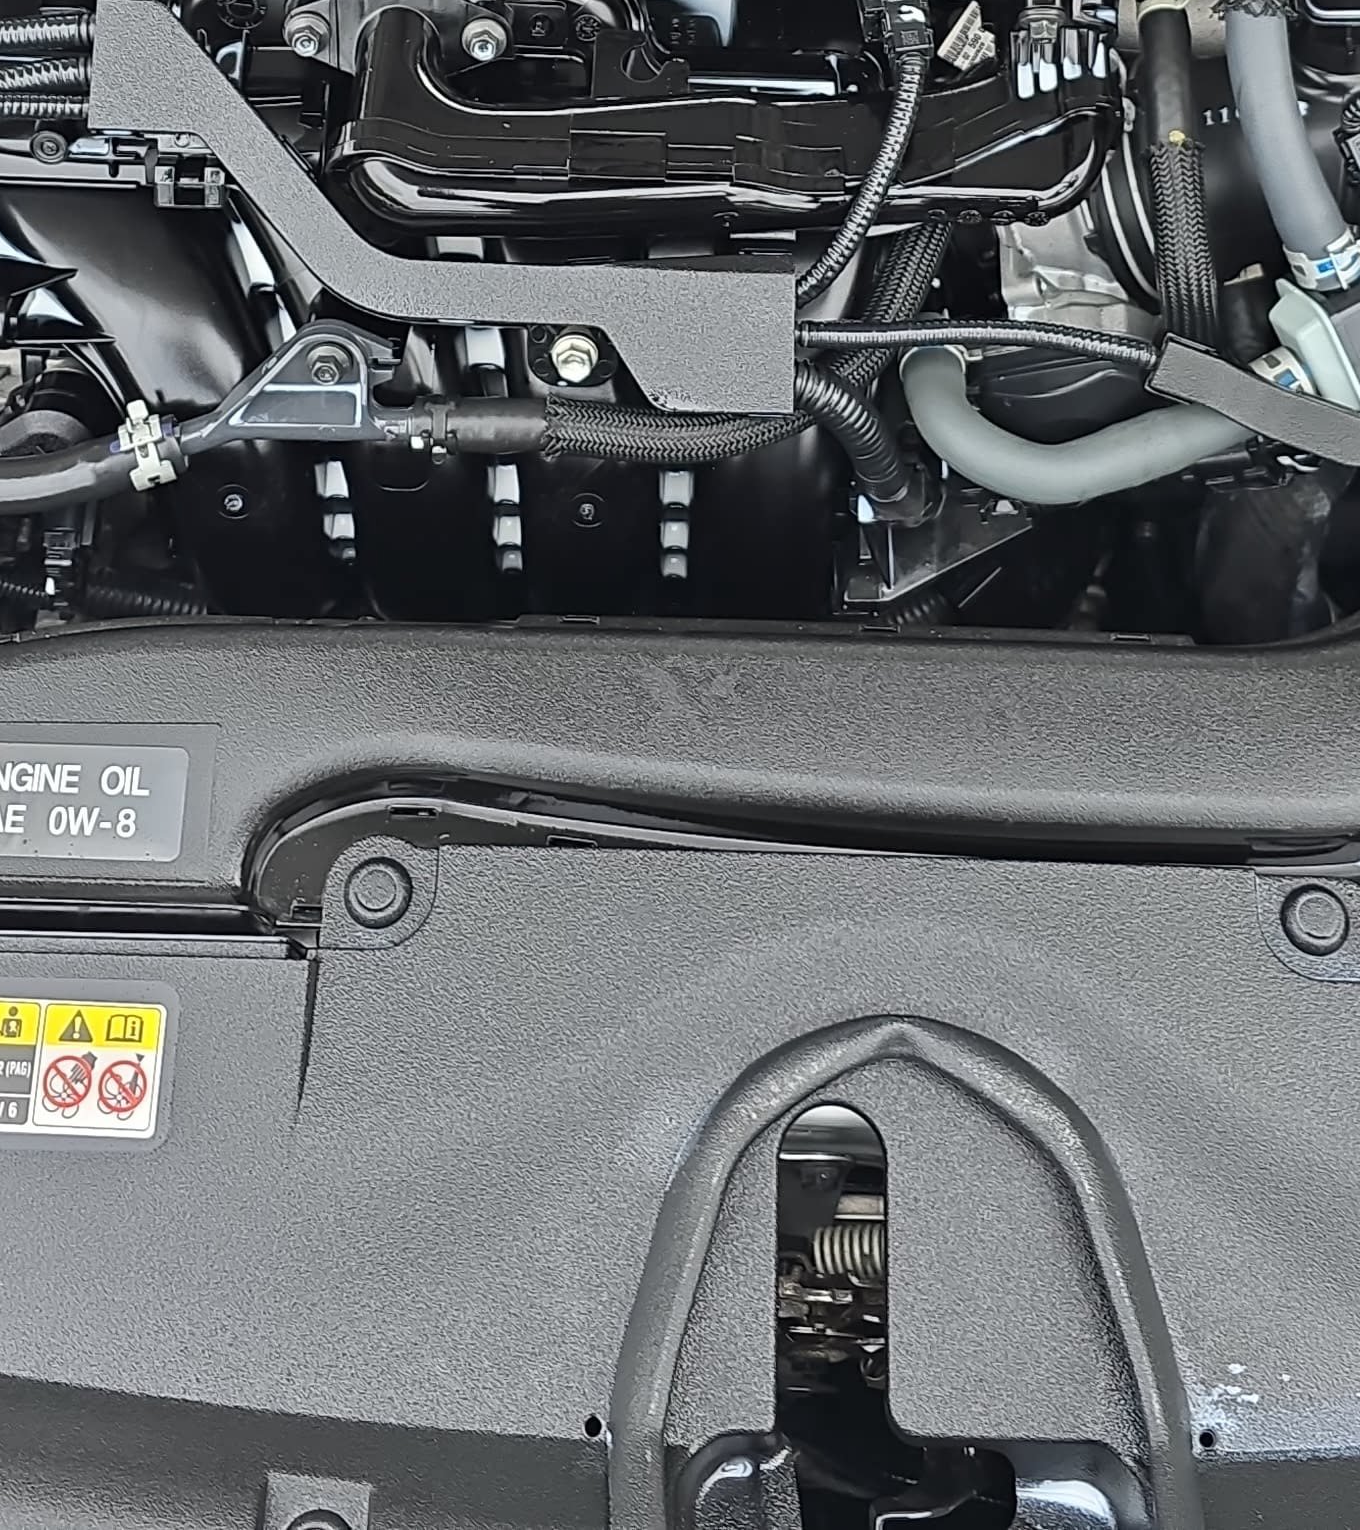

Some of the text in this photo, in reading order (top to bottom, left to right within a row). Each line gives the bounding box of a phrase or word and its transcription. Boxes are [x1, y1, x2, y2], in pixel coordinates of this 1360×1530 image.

[100, 765, 150, 797] OIL
[48, 805, 137, 839] 0W-8
[5, 1060, 32, 1078] (PAG)
[7, 1101, 18, 1119] 6
